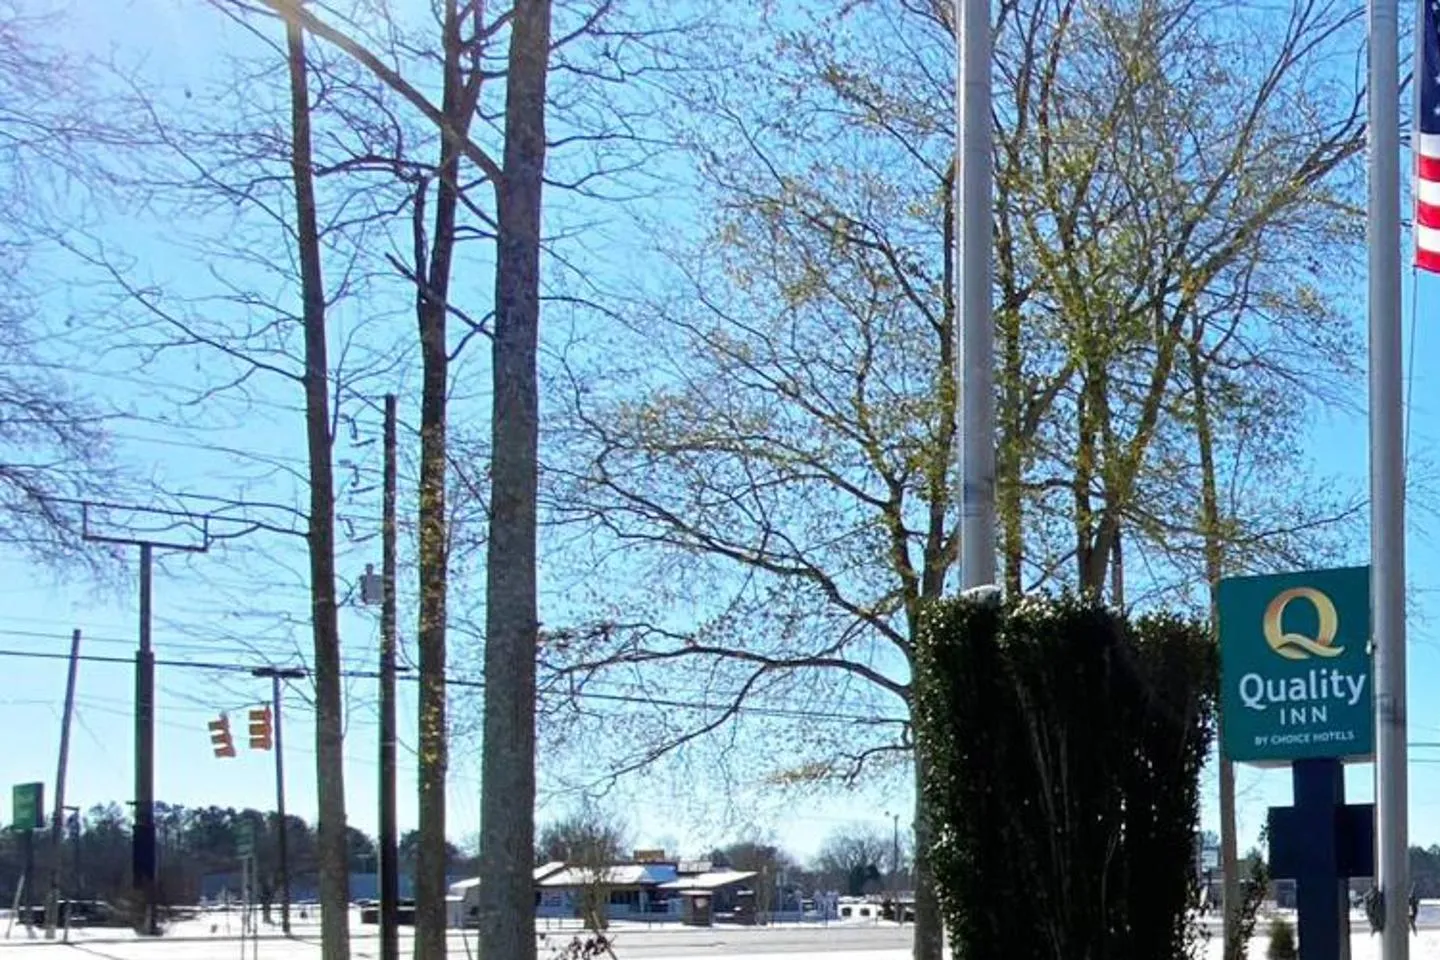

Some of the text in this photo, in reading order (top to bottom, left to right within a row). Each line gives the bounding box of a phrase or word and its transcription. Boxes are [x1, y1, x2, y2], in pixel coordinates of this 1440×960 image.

[1263, 586, 1345, 660] Q
[1239, 667, 1366, 710] Quality
[1279, 705, 1328, 725] INN
[1254, 730, 1355, 747] BY CHOICE HOTELS
